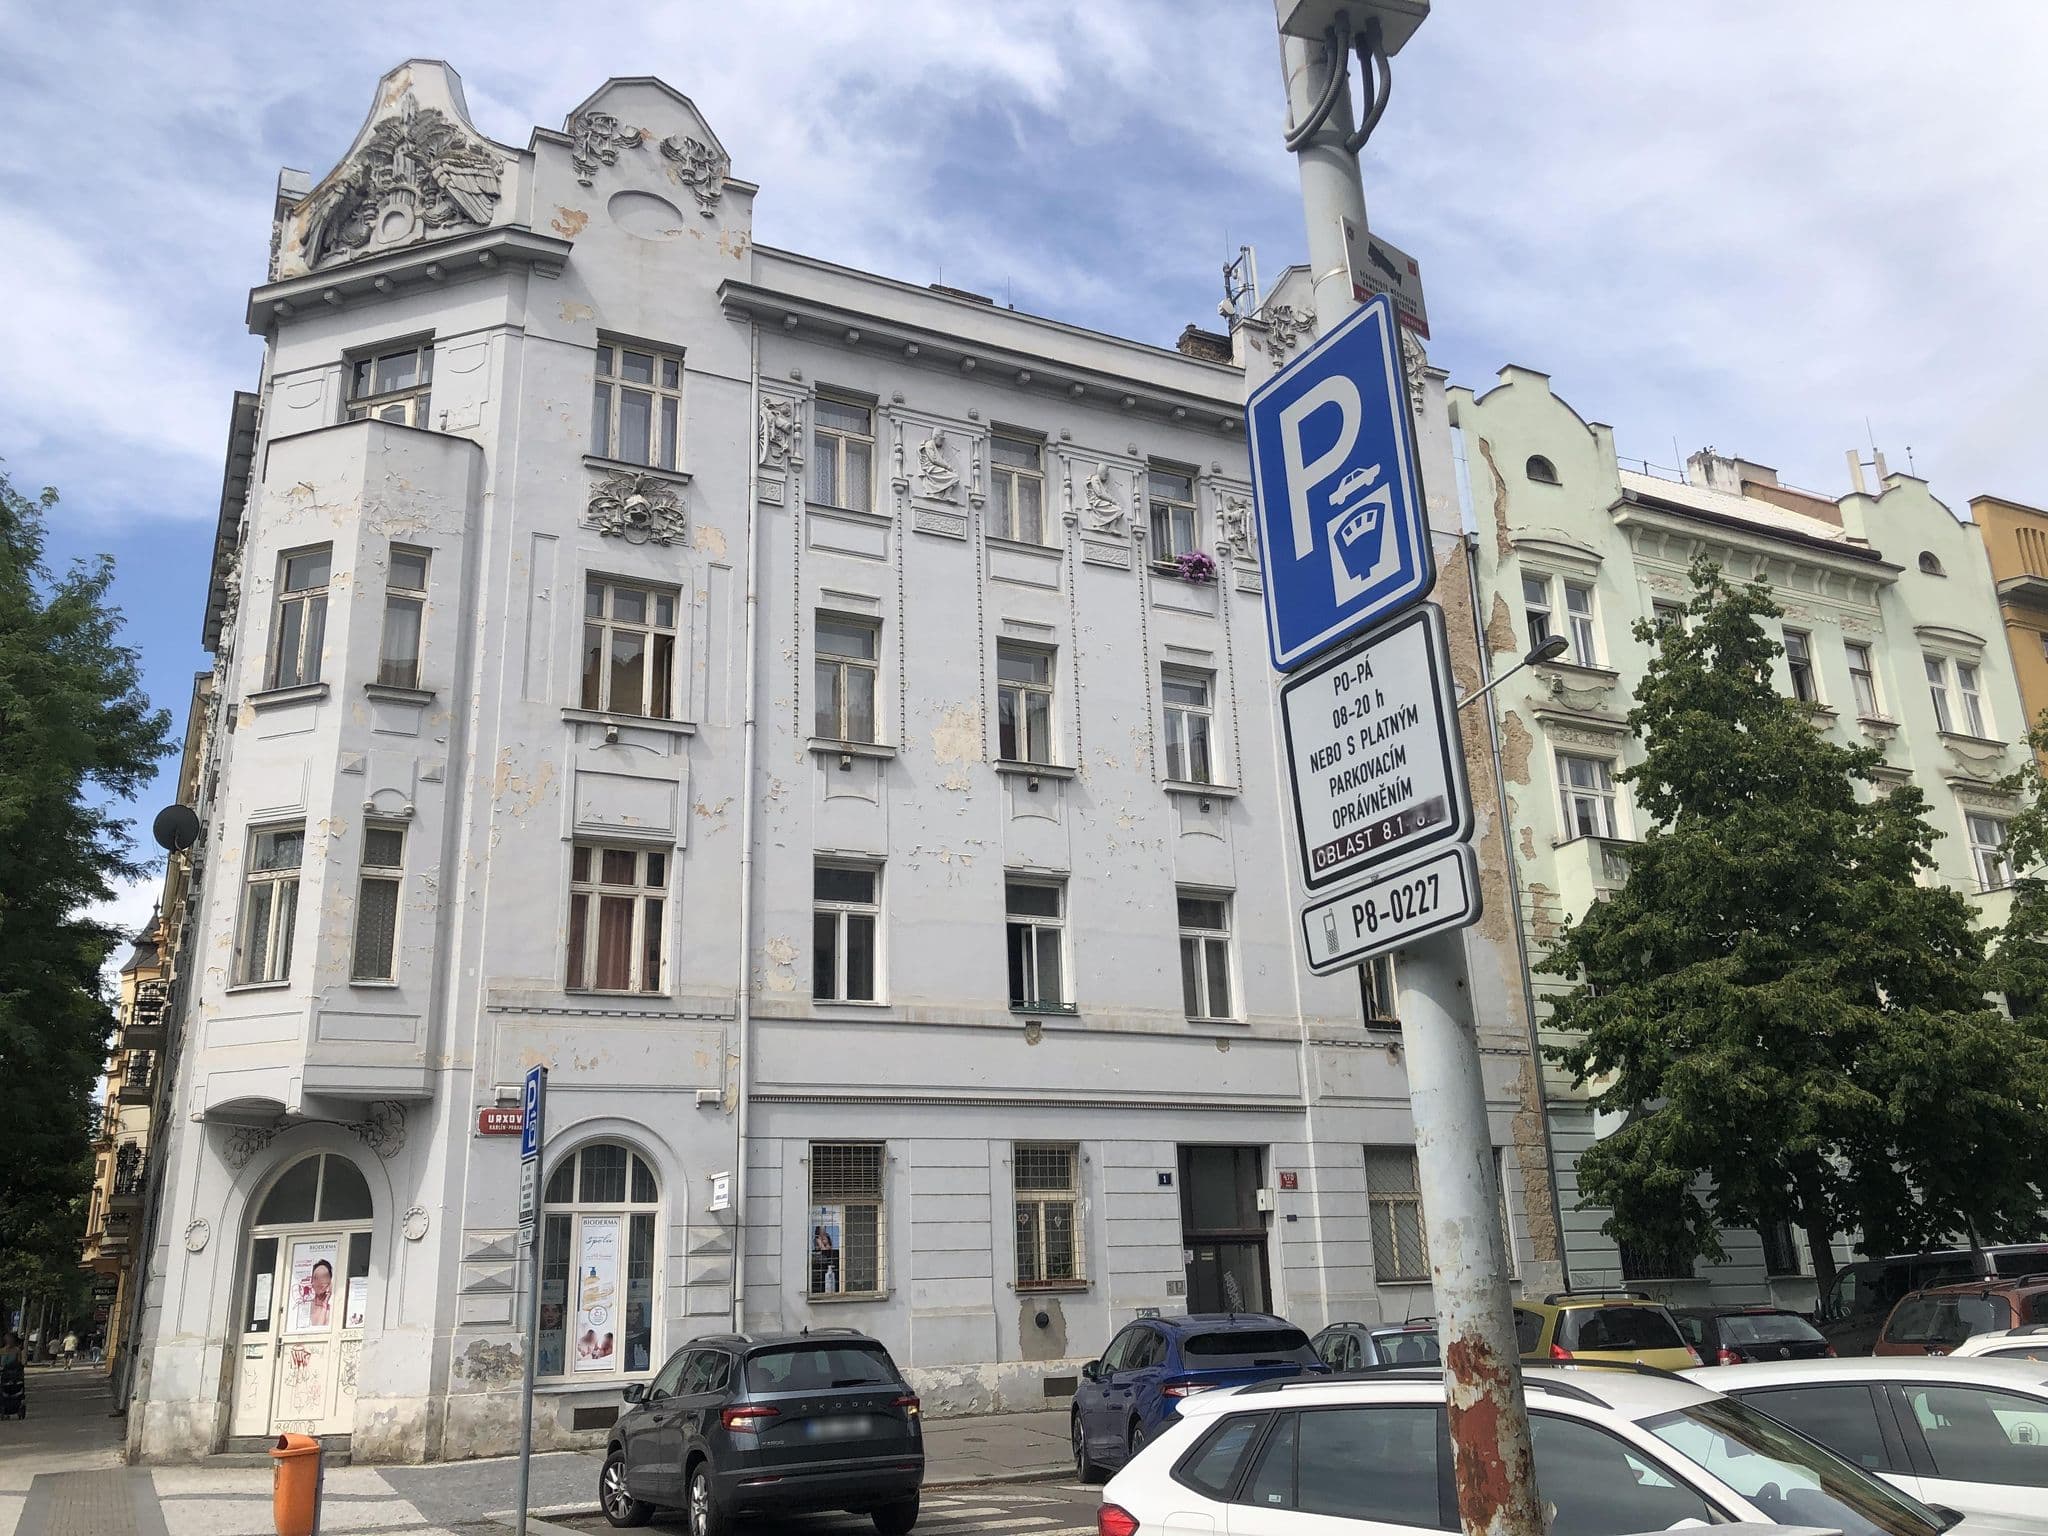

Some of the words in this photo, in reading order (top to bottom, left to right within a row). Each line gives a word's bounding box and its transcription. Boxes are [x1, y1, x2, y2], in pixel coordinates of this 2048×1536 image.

[1279, 375, 1361, 561] P
[1333, 653, 1374, 697] PO-PÁ
[1332, 694, 1371, 729] 08-20
[1375, 688, 1385, 708] h
[1310, 741, 1342, 774] NEBO
[1346, 735, 1355, 755] S
[1360, 703, 1419, 750] PLATNÝM
[1329, 743, 1407, 798] PARKOVACÍM
[1332, 775, 1413, 830] OPRÁVNĚNÍM
[1316, 828, 1373, 868] OBLAST
[1351, 873, 1439, 938] P8-0227
[487, 1114, 523, 1124] URXOV
